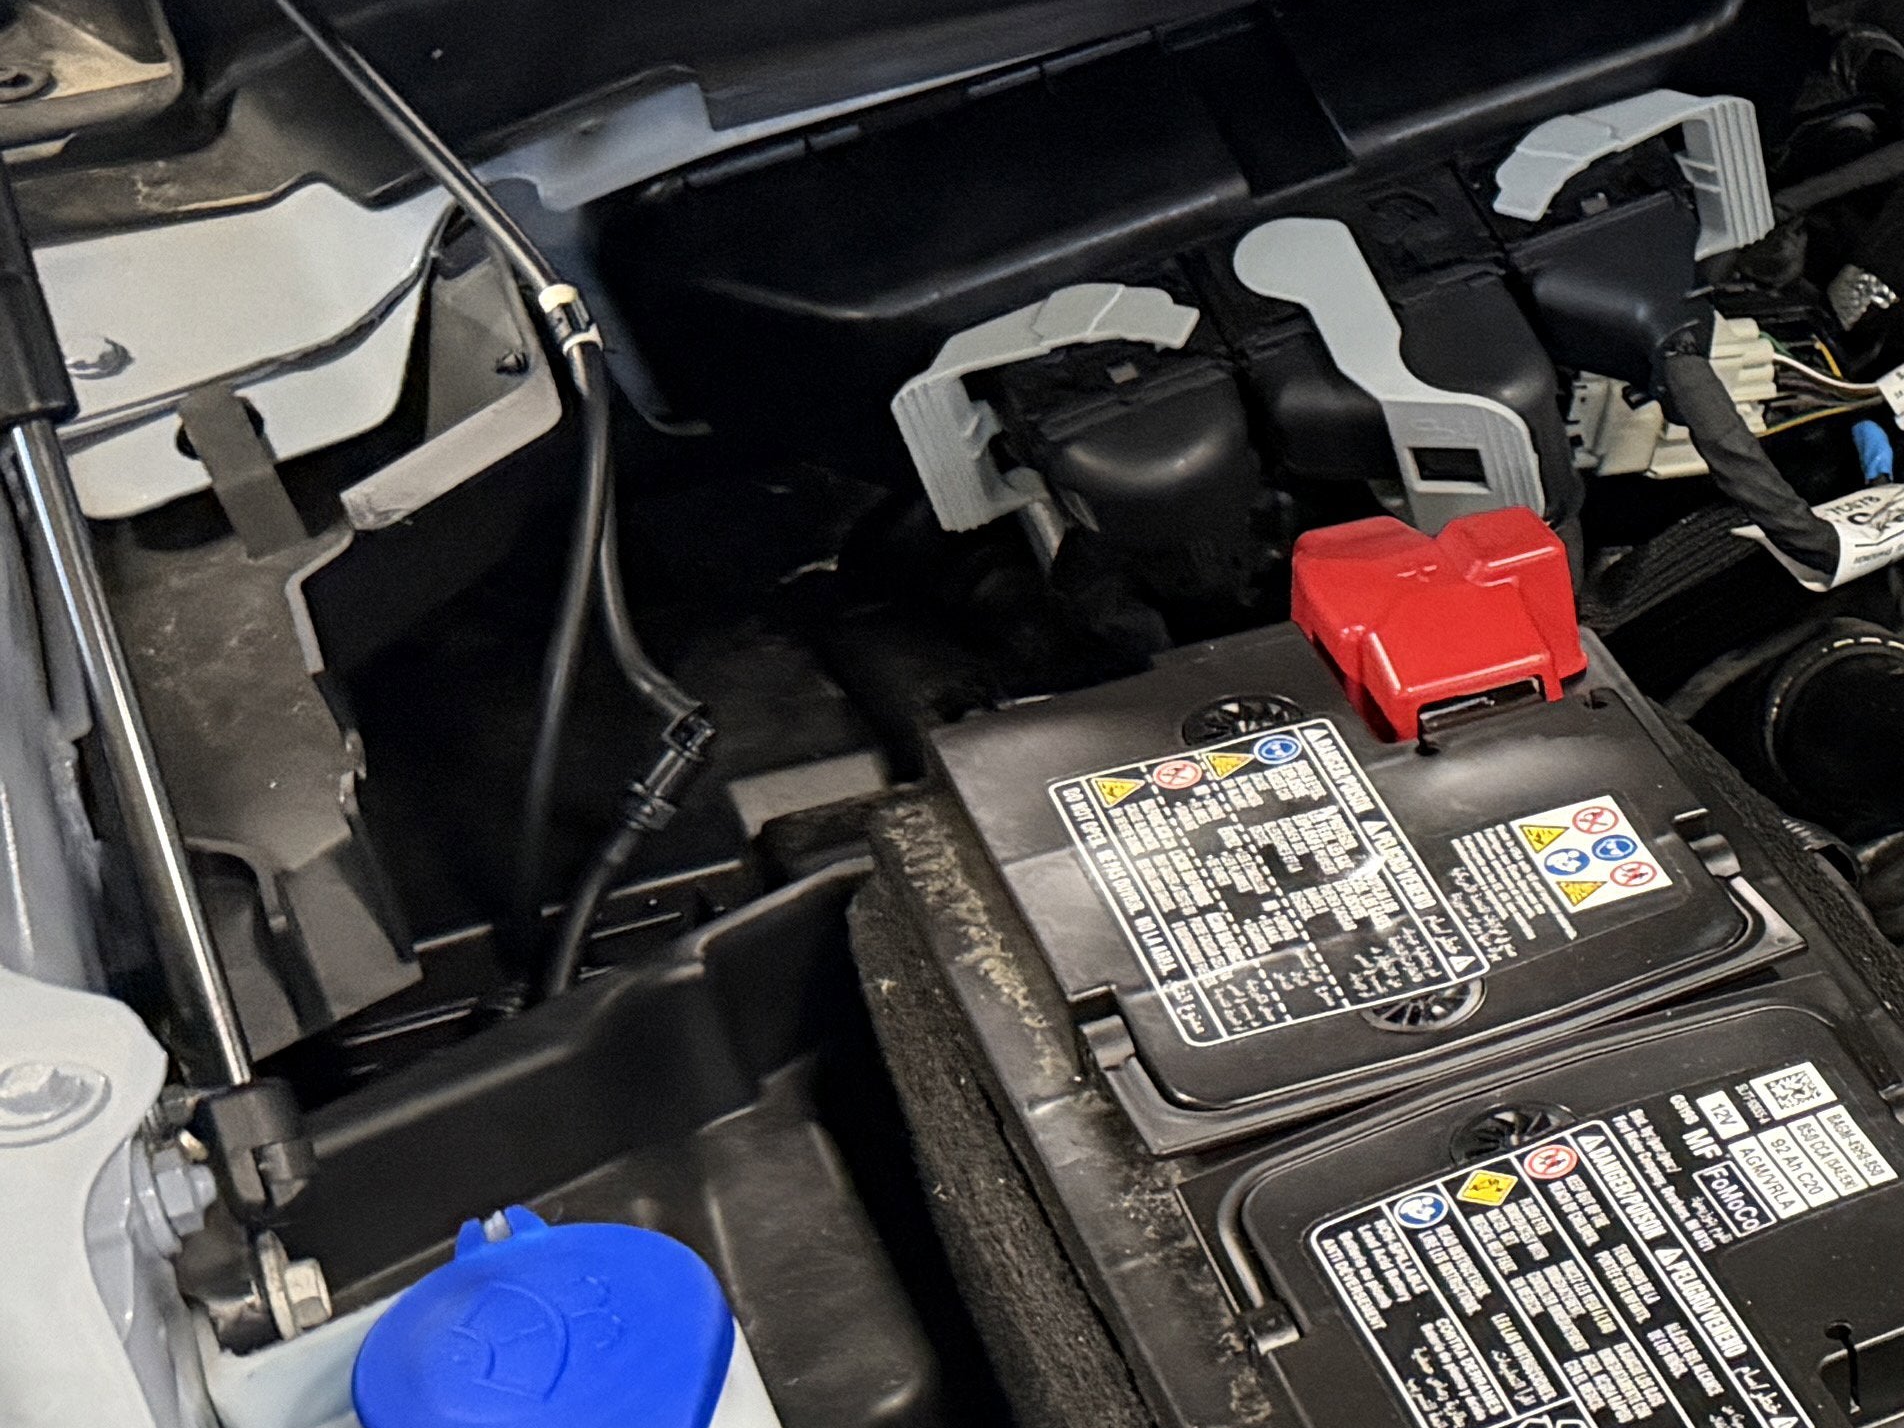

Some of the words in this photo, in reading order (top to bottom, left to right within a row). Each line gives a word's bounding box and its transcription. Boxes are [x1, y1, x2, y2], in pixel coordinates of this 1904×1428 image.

[1677, 1127, 1726, 1162] MF
[1706, 1102, 1738, 1127] 12V
[1586, 1144, 1668, 1241] DANGER/POISON
[1699, 1165, 1768, 1231] FoMoCo
[1736, 1145, 1798, 1210] AGM/VRLA
[1768, 1138, 1791, 1154] 92
[1782, 1154, 1806, 1172] Ah
[1795, 1171, 1824, 1196] C20
[1664, 1259, 1749, 1359] PELIGRO/VENENO
